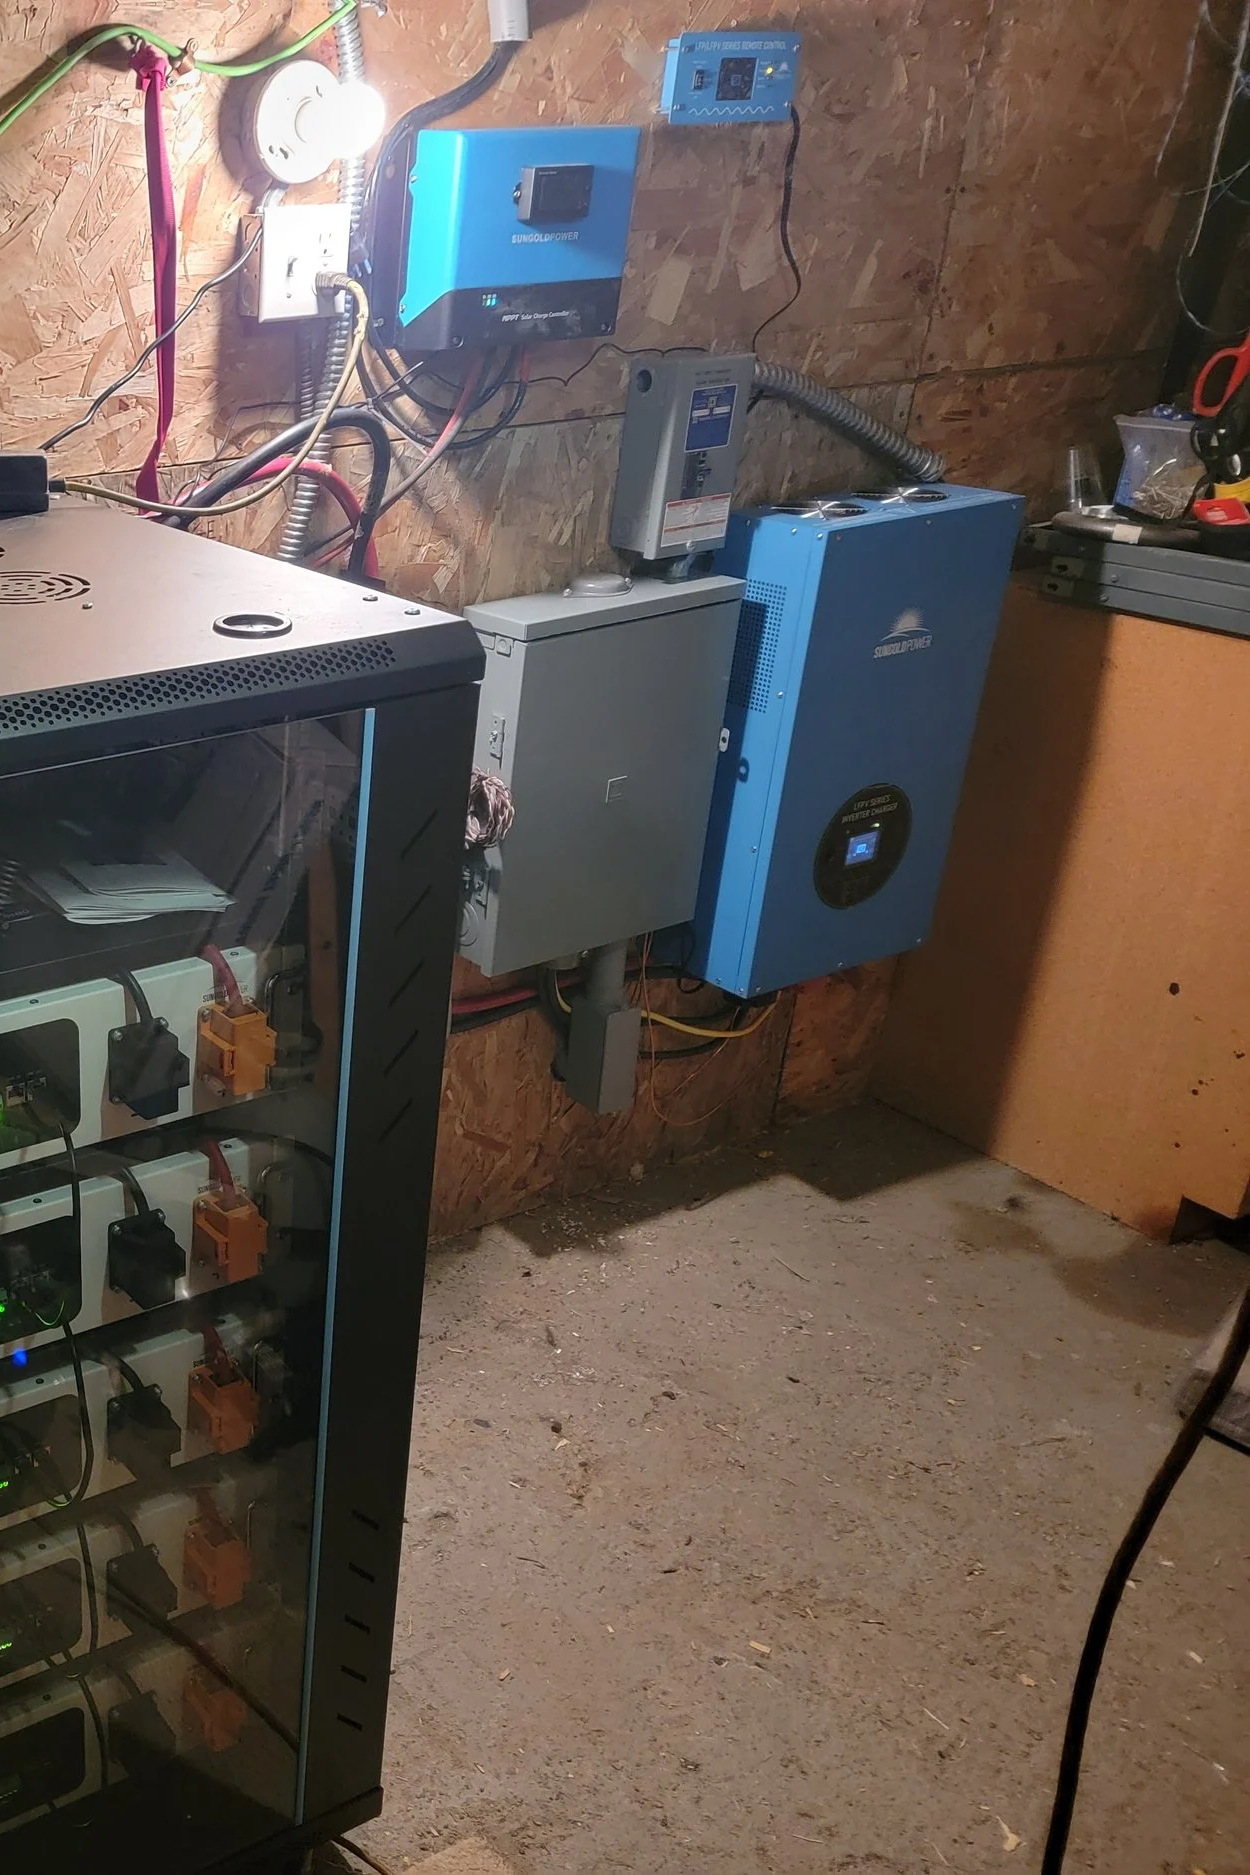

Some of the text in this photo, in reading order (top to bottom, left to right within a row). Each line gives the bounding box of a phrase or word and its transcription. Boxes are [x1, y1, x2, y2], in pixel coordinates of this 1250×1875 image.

[763, 41, 786, 50] CONTROL
[511, 231, 579, 244] SUNGOLDPOWER
[873, 635, 932, 658] SUNGOLDPOWER
[869, 794, 892, 807] SERIES
[841, 802, 899, 824] INVERTER CHARGER
